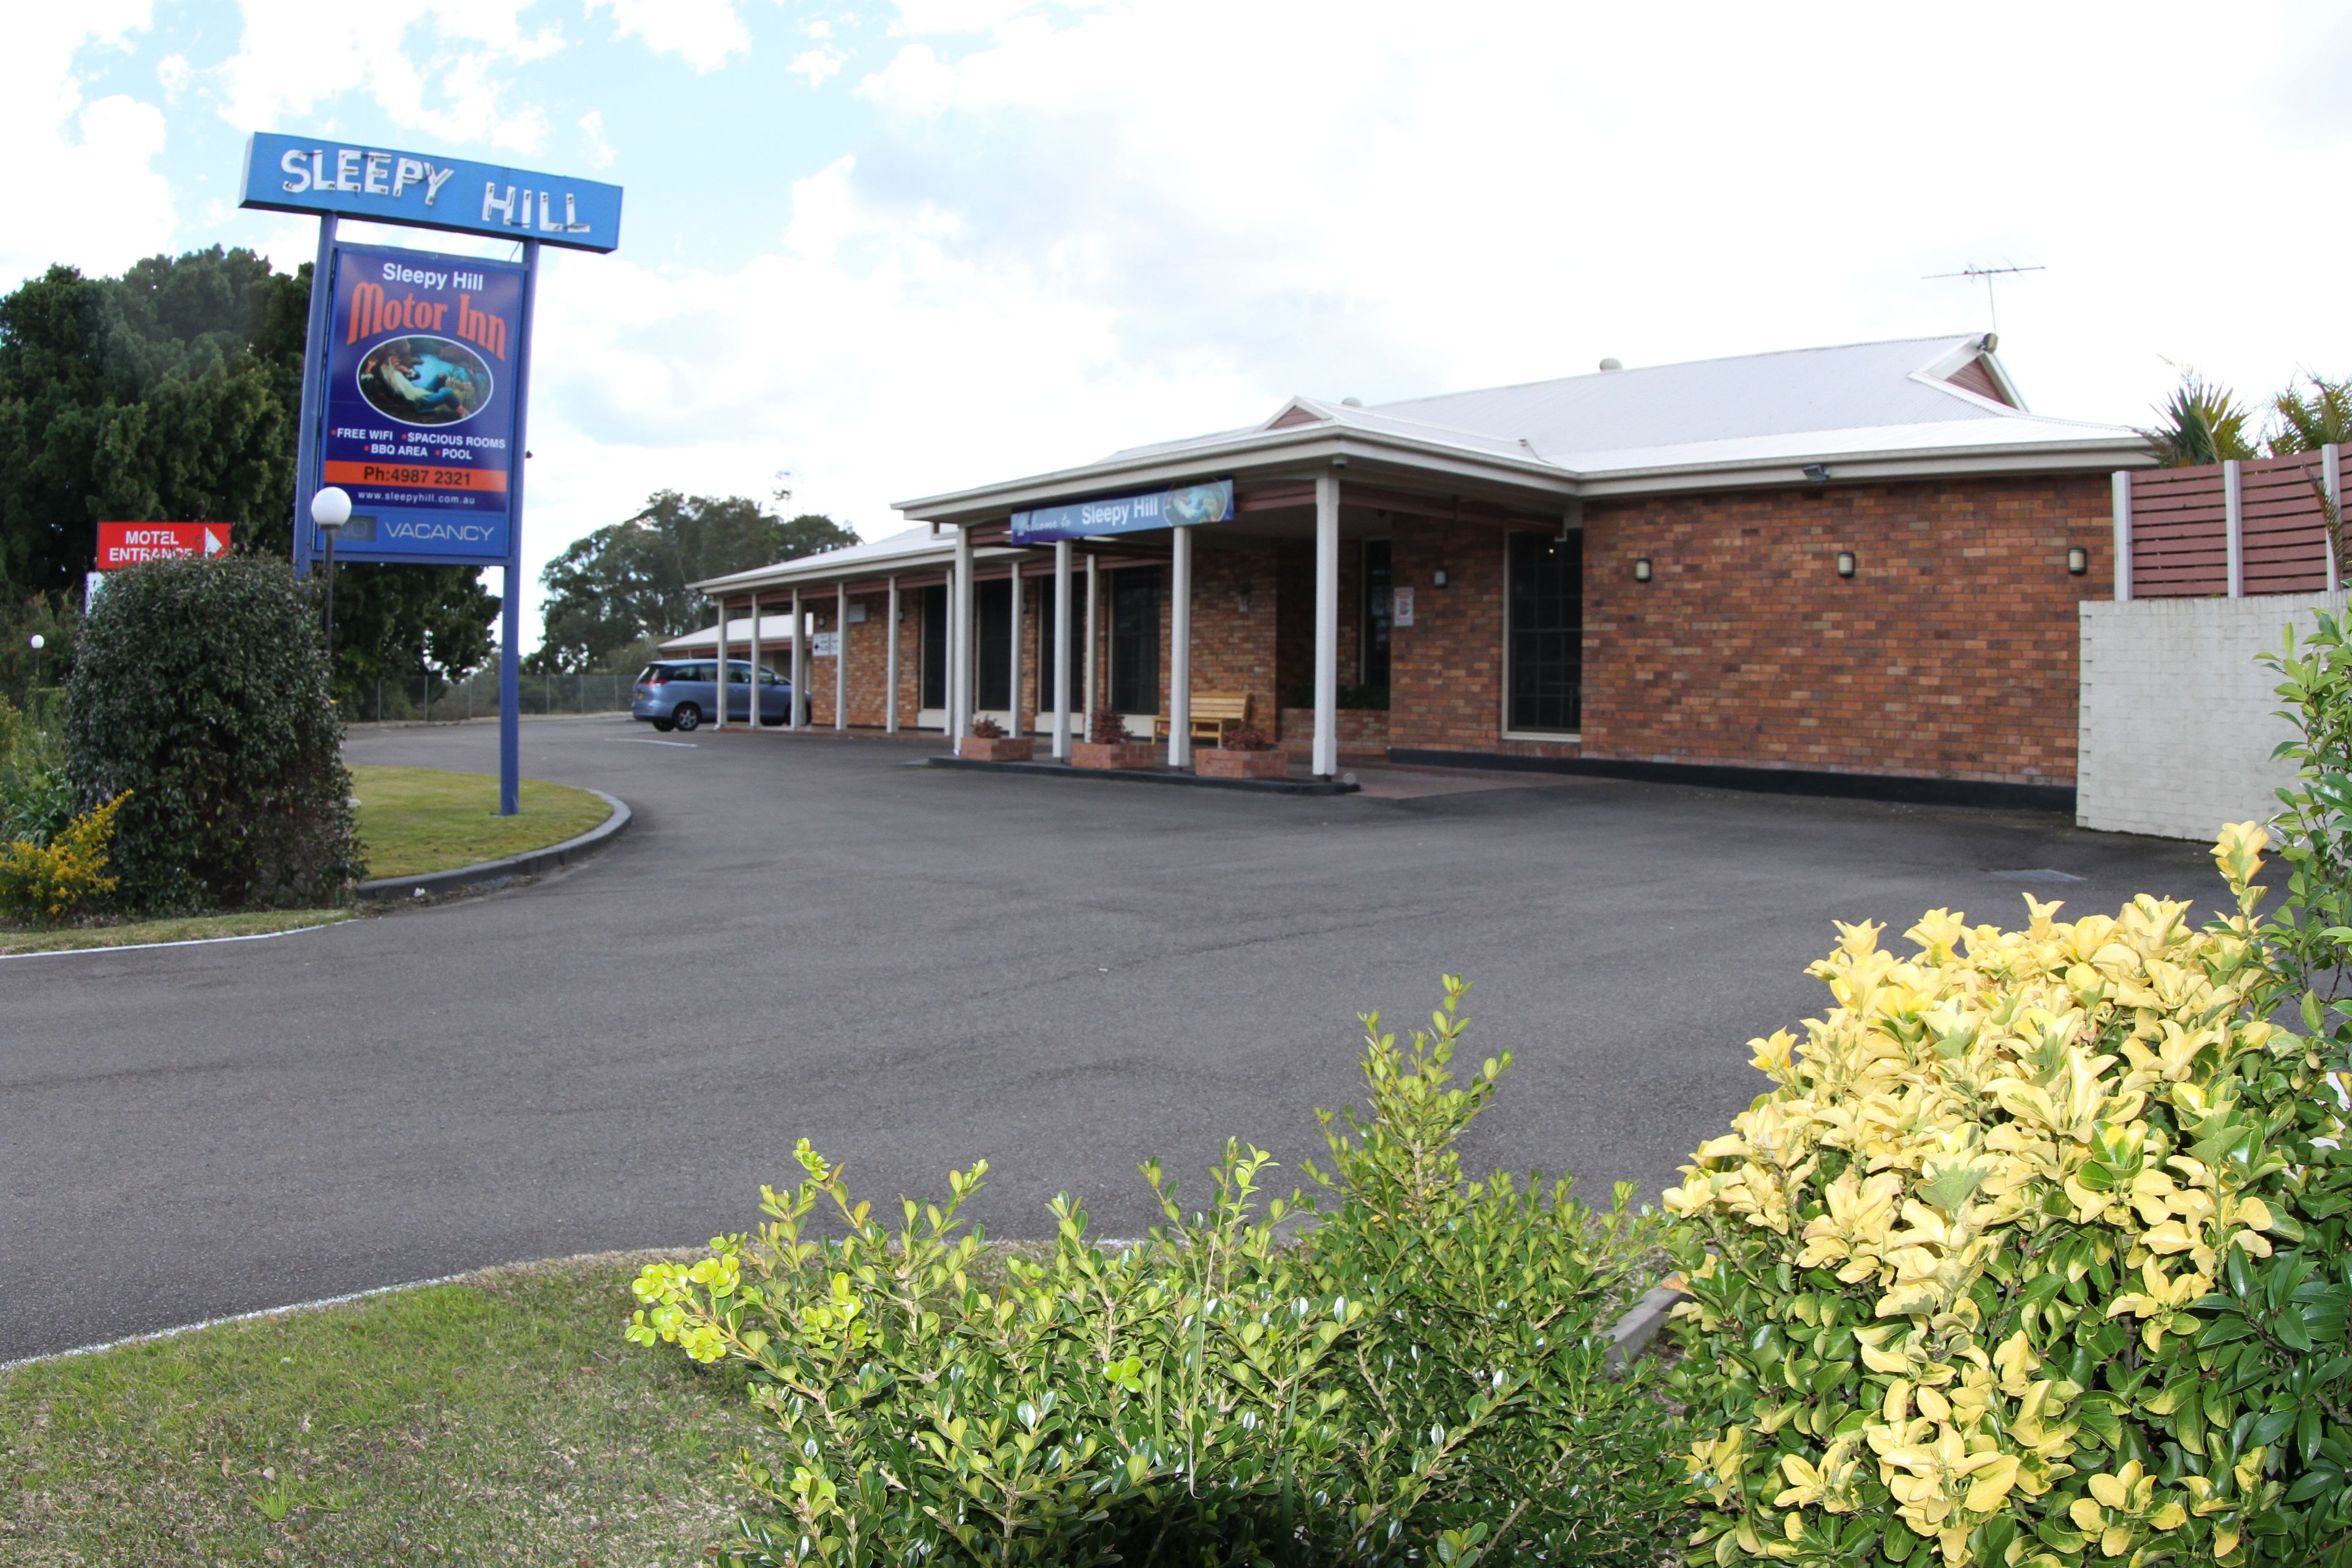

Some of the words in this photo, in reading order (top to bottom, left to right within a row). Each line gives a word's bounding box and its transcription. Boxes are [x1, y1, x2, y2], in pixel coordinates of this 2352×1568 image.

[281, 149, 454, 206] SLEEPY
[481, 181, 591, 233] HILL
[383, 263, 448, 291] Sleepy
[453, 271, 483, 291] Hill
[347, 282, 448, 345] Motor
[457, 293, 507, 361] Inn
[337, 428, 366, 439] FREE
[369, 430, 393, 440] WIFI
[407, 432, 464, 446] SPACIOUS
[466, 437, 506, 449] ROOMS
[371, 443, 395, 454] BBQ
[398, 445, 428, 456] AREA
[442, 448, 472, 459] POOL
[364, 466, 429, 483] Ph:4987
[434, 470, 470, 485] 2321
[358, 491, 475, 504] www.sleepyhill.com.au
[1082, 504, 1129, 527] Sleepy
[1134, 497, 1158, 518] Hill
[126, 530, 179, 545] MOTEL
[385, 522, 494, 541] VACANCY
